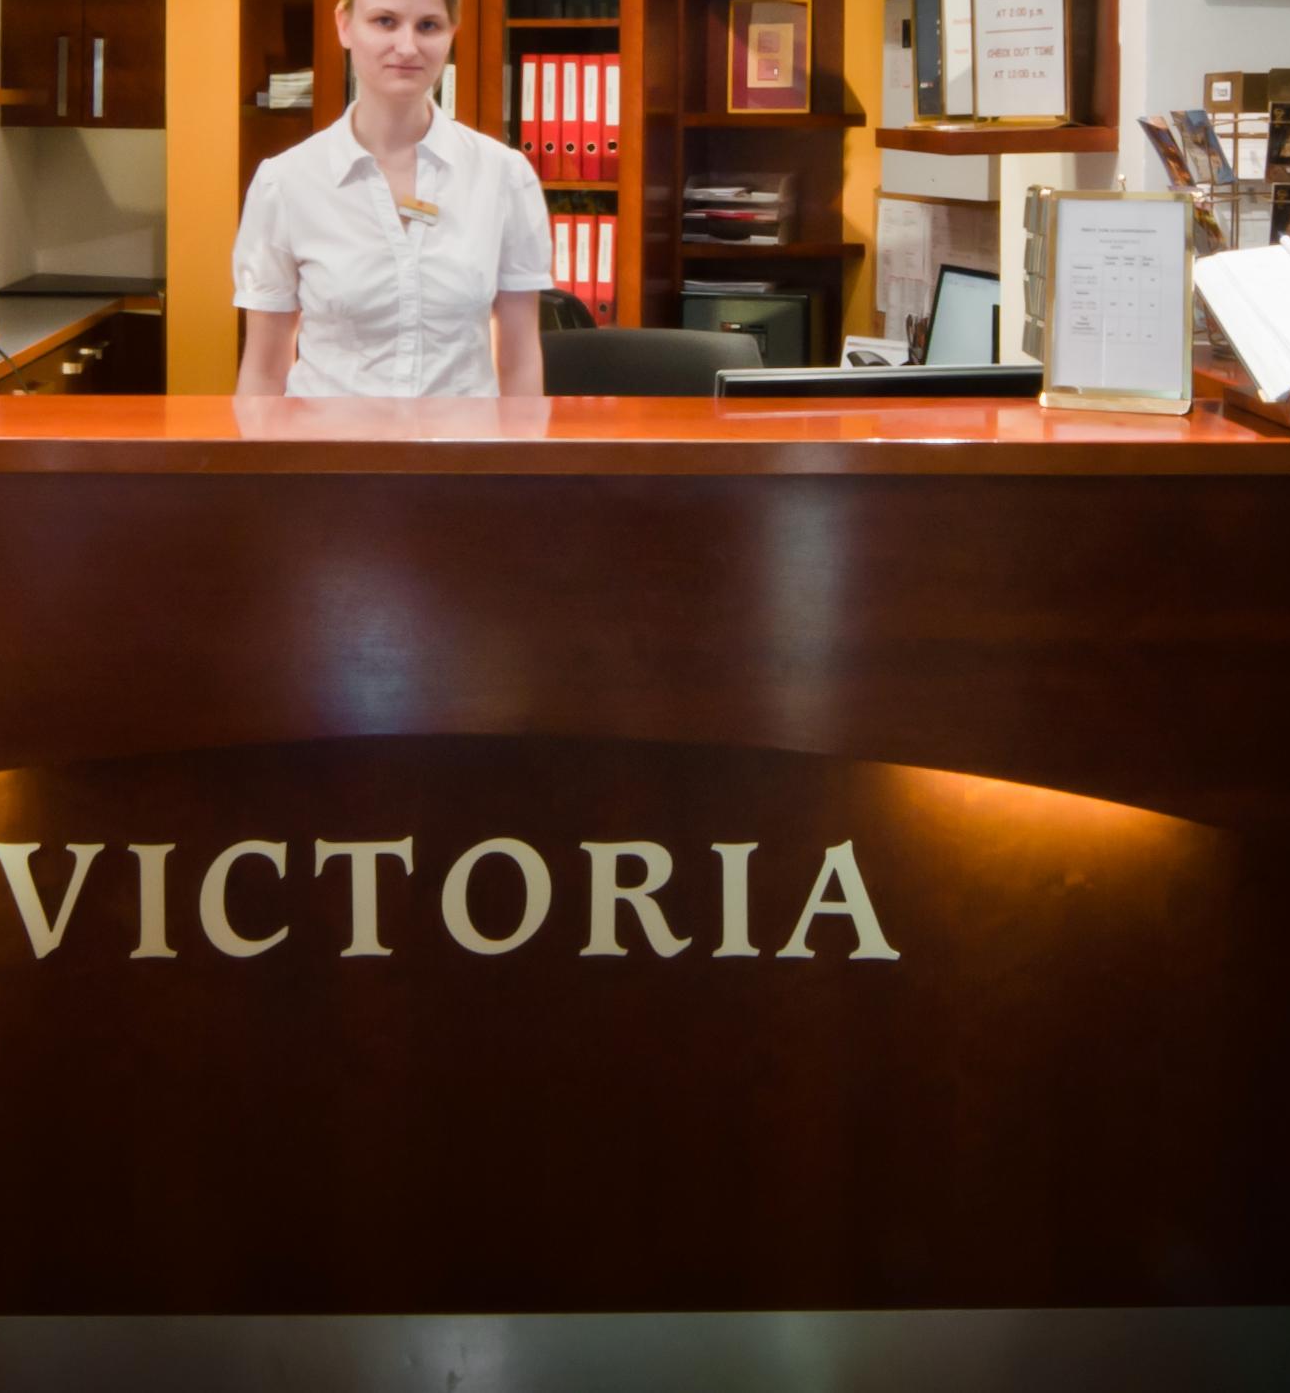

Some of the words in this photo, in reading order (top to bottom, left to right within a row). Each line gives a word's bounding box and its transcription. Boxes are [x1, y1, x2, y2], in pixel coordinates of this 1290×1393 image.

[996, 8, 1007, 19] AT
[1009, 7, 1027, 18] 2:00
[987, 47, 1011, 59] CHECK
[1013, 46, 1031, 58] OUT
[1034, 45, 1055, 56] TIME
[993, 69, 1004, 80] AT
